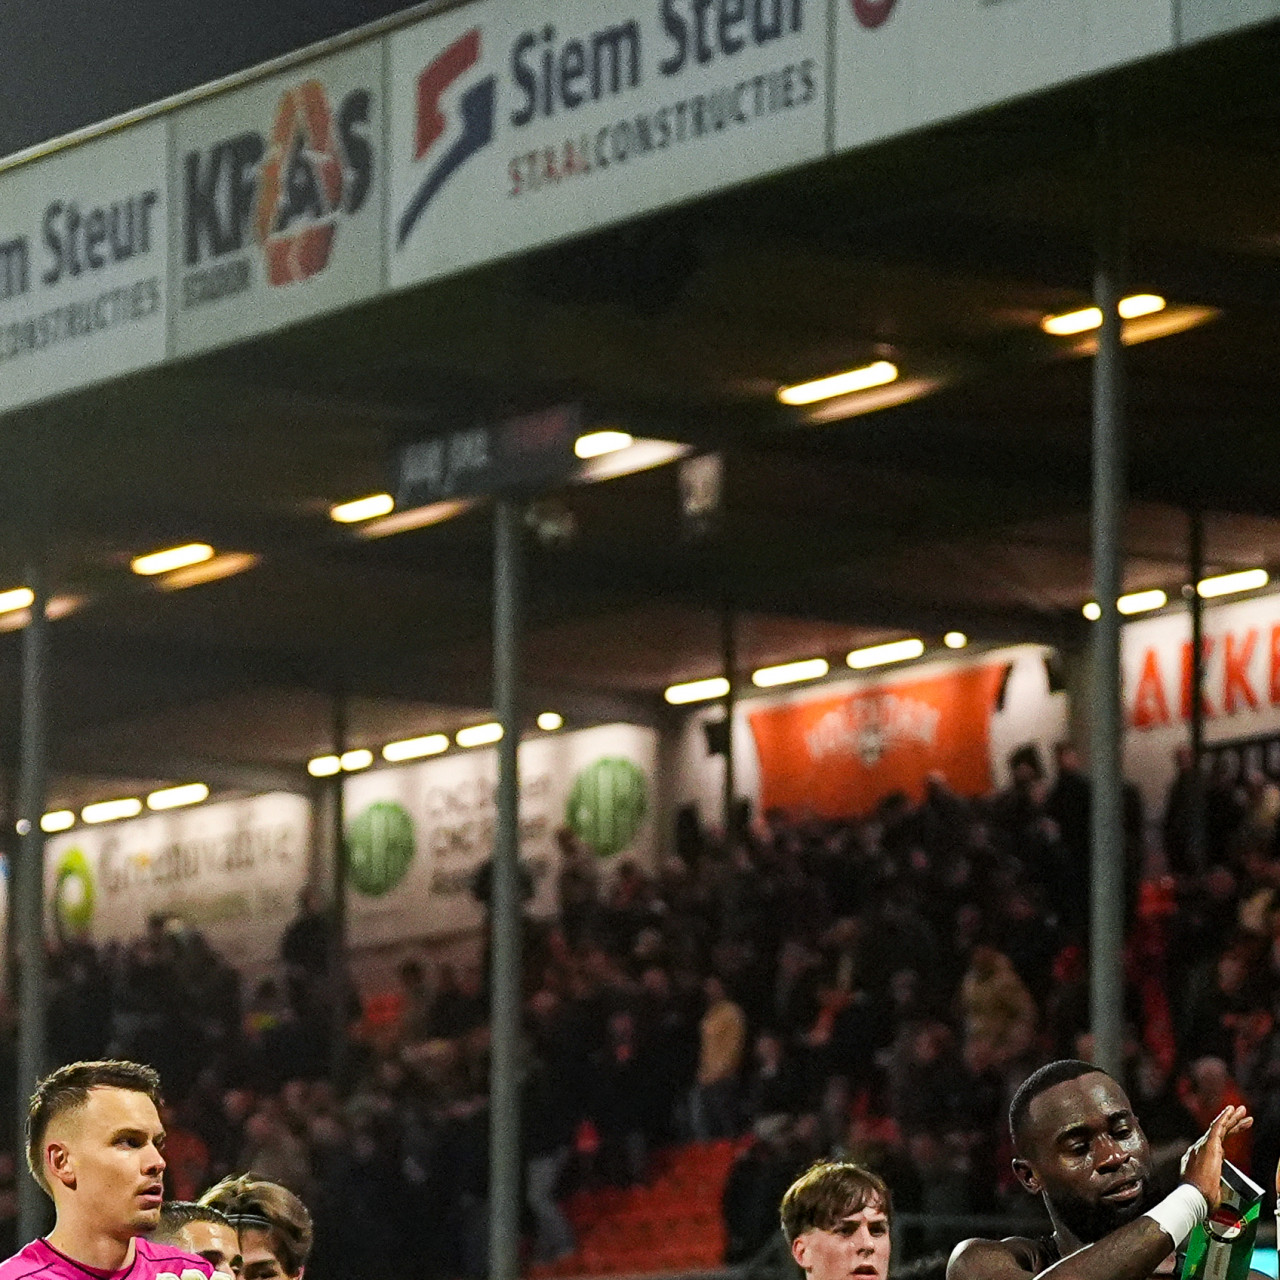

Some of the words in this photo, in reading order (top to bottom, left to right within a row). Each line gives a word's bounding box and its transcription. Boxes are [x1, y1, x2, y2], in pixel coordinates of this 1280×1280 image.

[510, 20, 642, 128] Siem
[183, 86, 374, 268] KRAS
[40, 188, 160, 286] Steur
